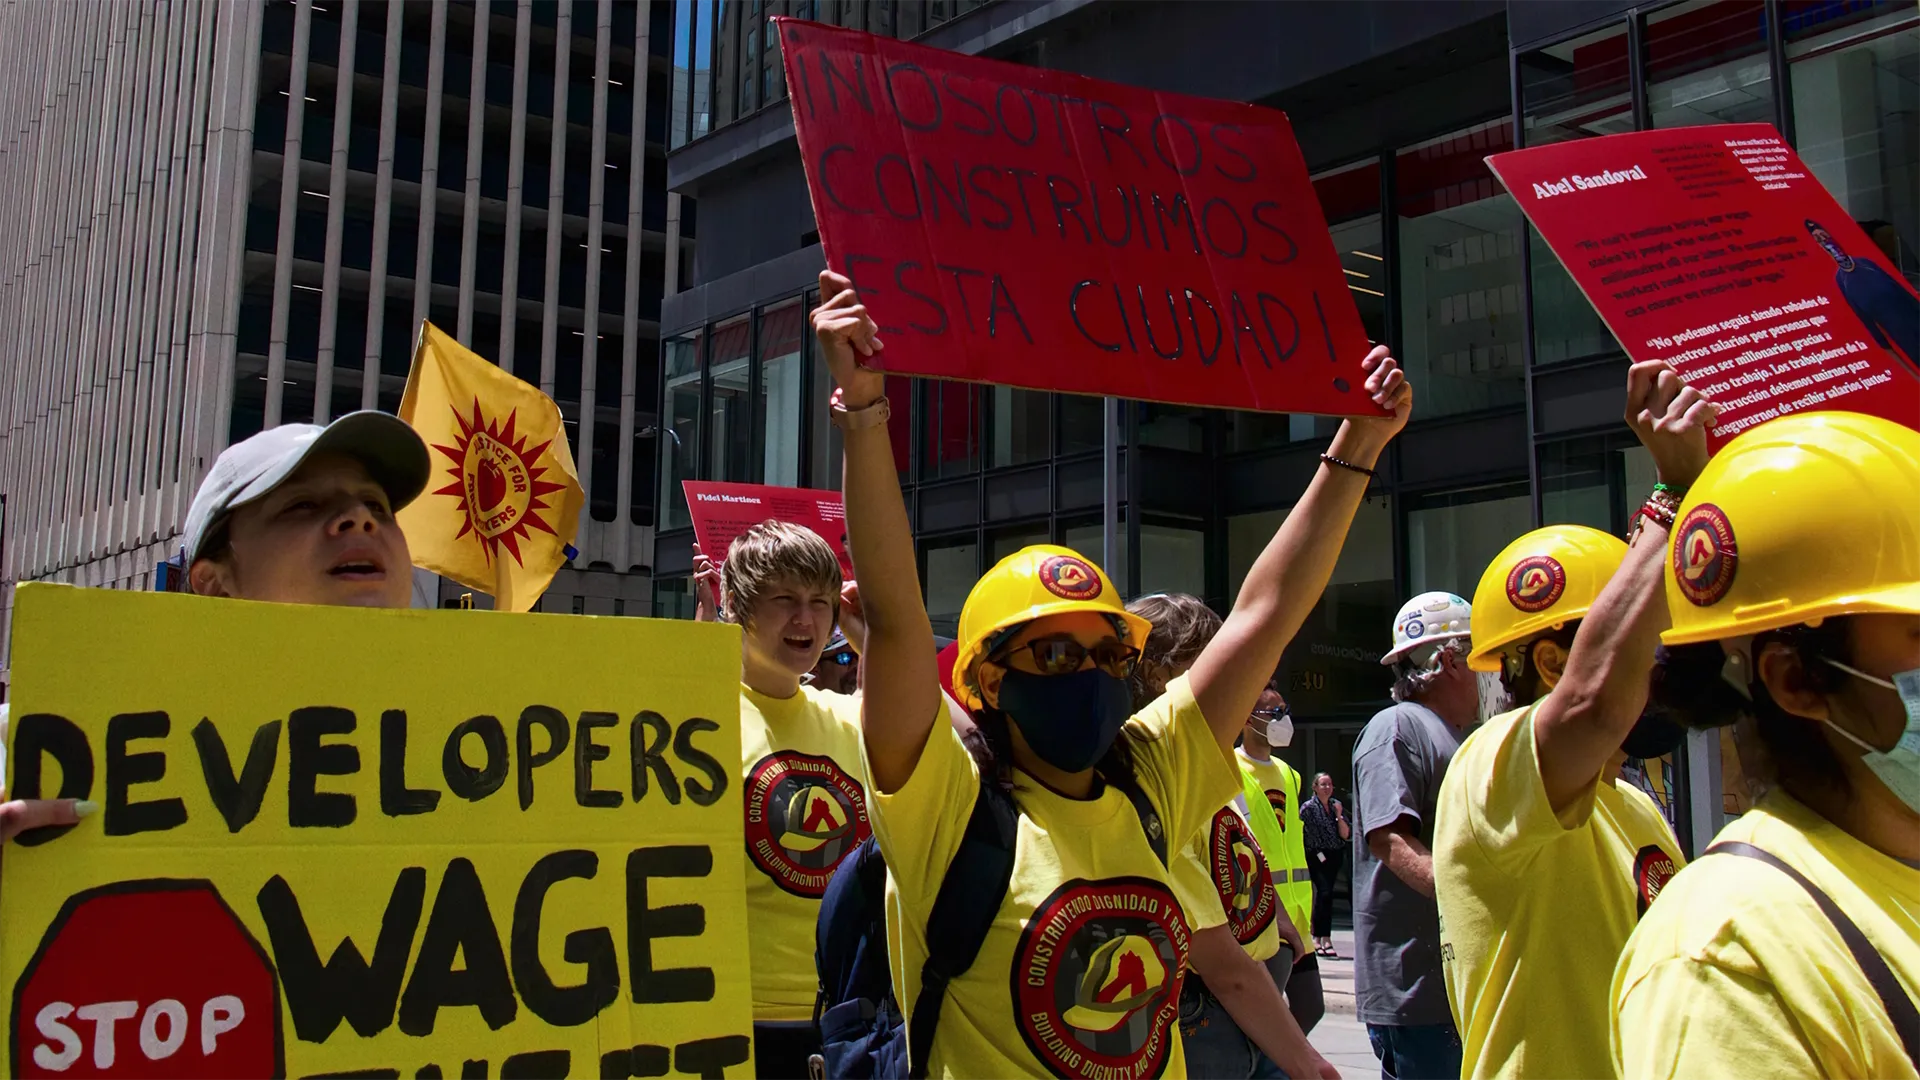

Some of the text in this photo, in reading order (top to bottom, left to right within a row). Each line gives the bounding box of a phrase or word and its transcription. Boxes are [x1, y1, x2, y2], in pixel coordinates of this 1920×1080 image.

[819, 143, 1299, 265] CONSTRUIMOS
[1532, 177, 1576, 200] Abel
[1572, 164, 1647, 190] Sandoval
[844, 253, 1351, 394] ESTA CIUDAD!
[1672, 323, 1721, 346] podemos
[1719, 314, 1751, 330] seguir
[1750, 305, 1783, 321] siendo
[1782, 298, 1819, 314] robados
[1817, 295, 1830, 305] de
[1709, 335, 1751, 354] salarios
[1749, 327, 1769, 343] por
[1768, 318, 1812, 338] personas
[1809, 315, 1828, 327] que
[1678, 332, 1832, 383] uieren ser millonarios gracias a
[1700, 340, 1868, 399] estro trabajo. Los trabajadores de la
[1712, 407, 1780, 438] asegurarnos
[1778, 402, 1793, 414] de
[1792, 391, 1826, 410] recibir
[1825, 380, 1863, 399] salarios
[1718, 360, 1870, 414] strucción debemos unirnos para
[508, 465, 527, 493] FOR
[697, 493, 721, 503] Fidel
[12, 705, 729, 847] DEVELOPERS
[749, 759, 867, 823] CONSTRUYENDO DIGNIDAD Y RESPETO
[756, 838, 792, 878] BUILDING
[789, 871, 825, 888] DIGNITY
[1254, 883, 1273, 920] RESPECT
[256, 844, 716, 1044] WAGE
[1028, 895, 1091, 987] CONSTRUYENDO
[1092, 894, 1158, 914] DIGNIDAD
[1163, 905, 1171, 920] Y
[1169, 916, 1189, 979] RESPETO
[32, 994, 245, 1071] STOP
[1031, 1002, 1176, 1080] BUILDING DIGNITY AND RESPECT
